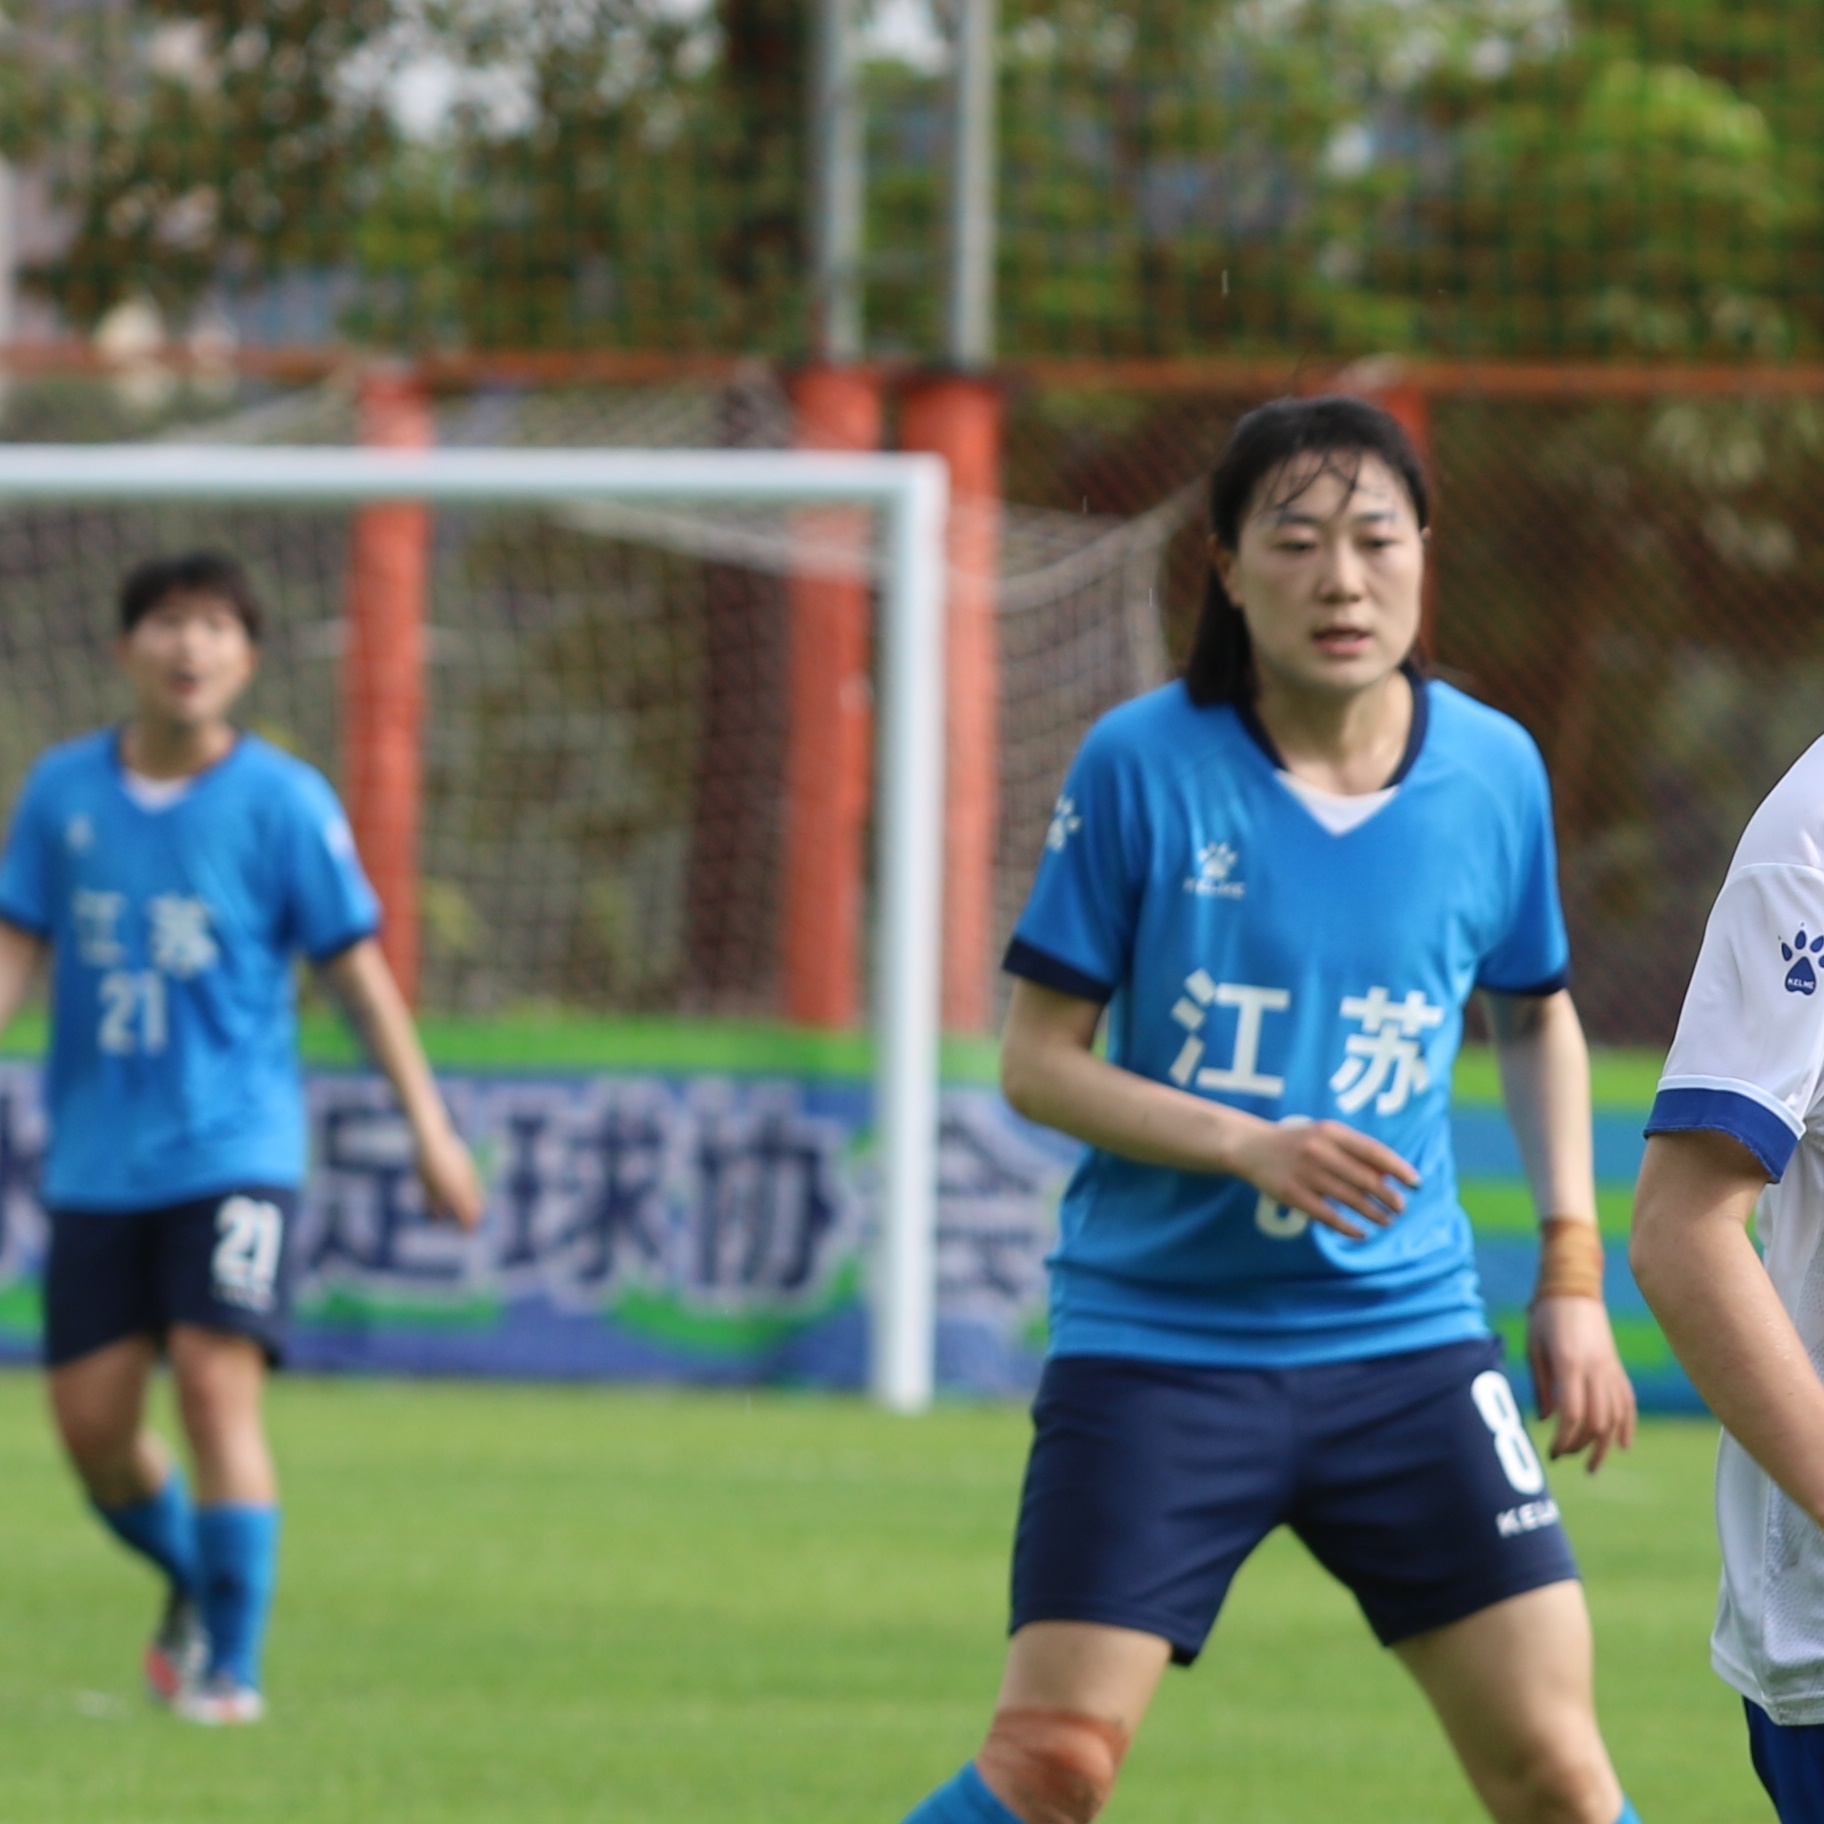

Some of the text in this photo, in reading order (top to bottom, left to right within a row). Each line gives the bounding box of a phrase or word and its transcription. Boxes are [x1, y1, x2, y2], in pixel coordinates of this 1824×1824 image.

[98, 969, 170, 1056] 21
[1169, 969, 1443, 1117] 江苏
[210, 1194, 283, 1290] 21
[1471, 1370, 1545, 1494] 8
